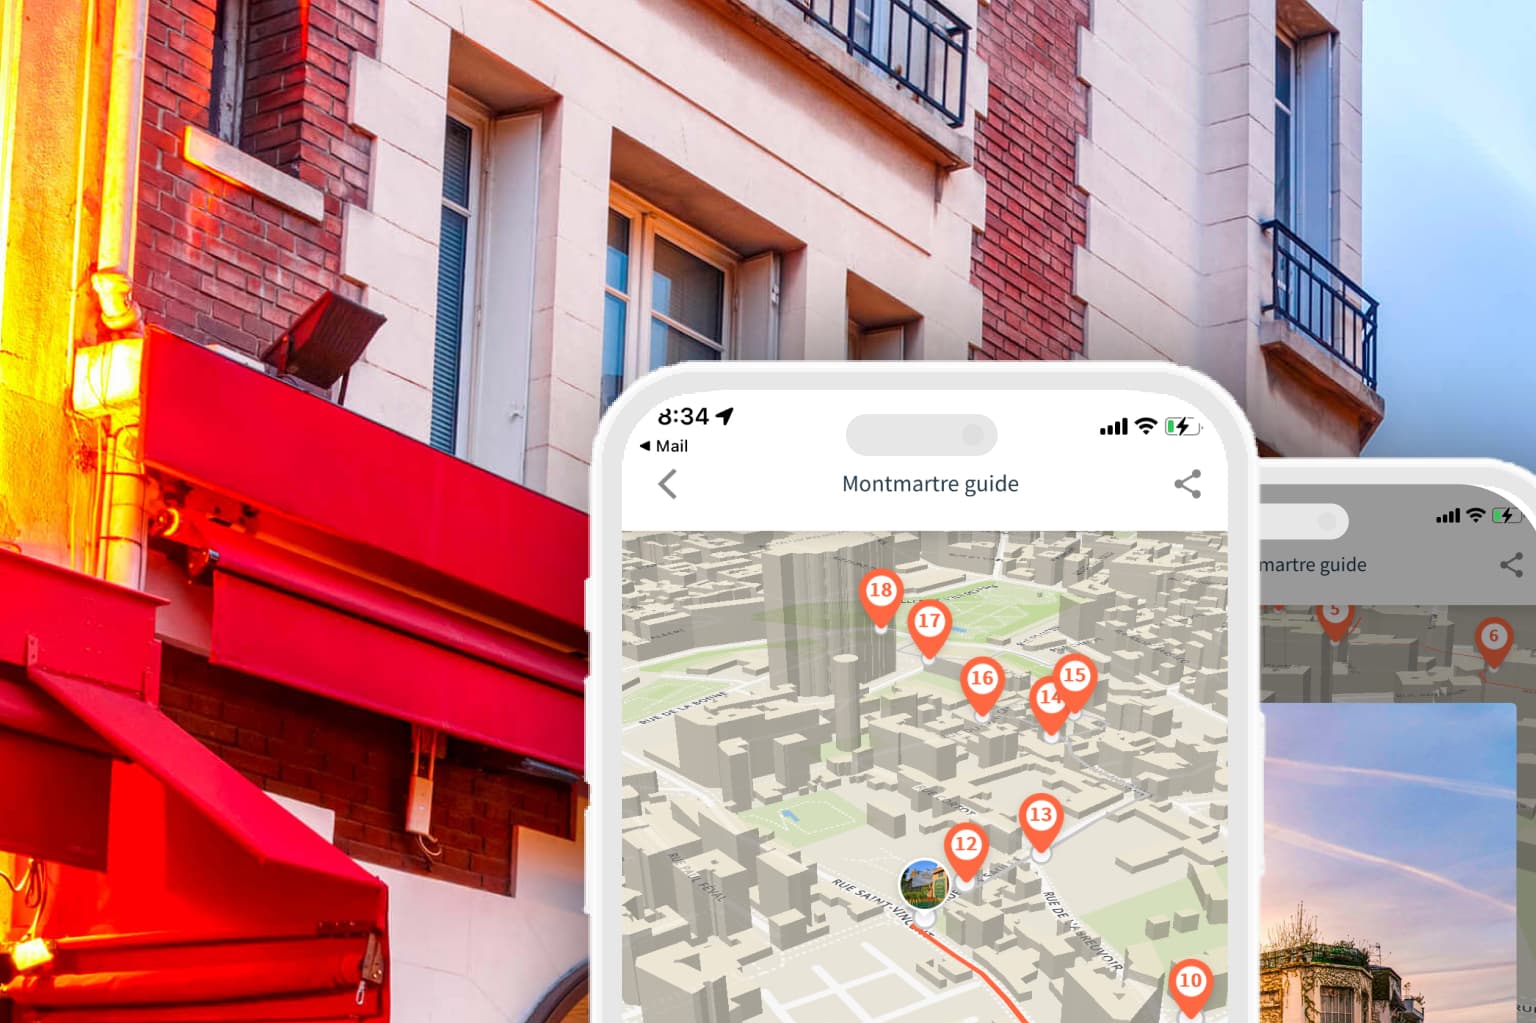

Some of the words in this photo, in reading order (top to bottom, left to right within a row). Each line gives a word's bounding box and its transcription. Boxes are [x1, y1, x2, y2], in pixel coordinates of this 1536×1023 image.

[658, 407, 710, 426] 8:34
[656, 439, 688, 453] Mail
[843, 474, 960, 493] Montmartre
[965, 473, 1019, 498] guide
[1320, 556, 1367, 577] guide
[869, 582, 893, 598] 18
[918, 612, 941, 628] 17
[1489, 628, 1499, 642] 6
[971, 670, 995, 686] 16
[1063, 667, 1087, 683] 15
[1039, 689, 1062, 705] 14
[1029, 807, 1053, 823] 13
[954, 836, 978, 852] 12
[831, 878, 856, 893] RUE
[1043, 891, 1061, 906] RUE
[1051, 907, 1070, 919] DE
[1179, 973, 1203, 988] 10
